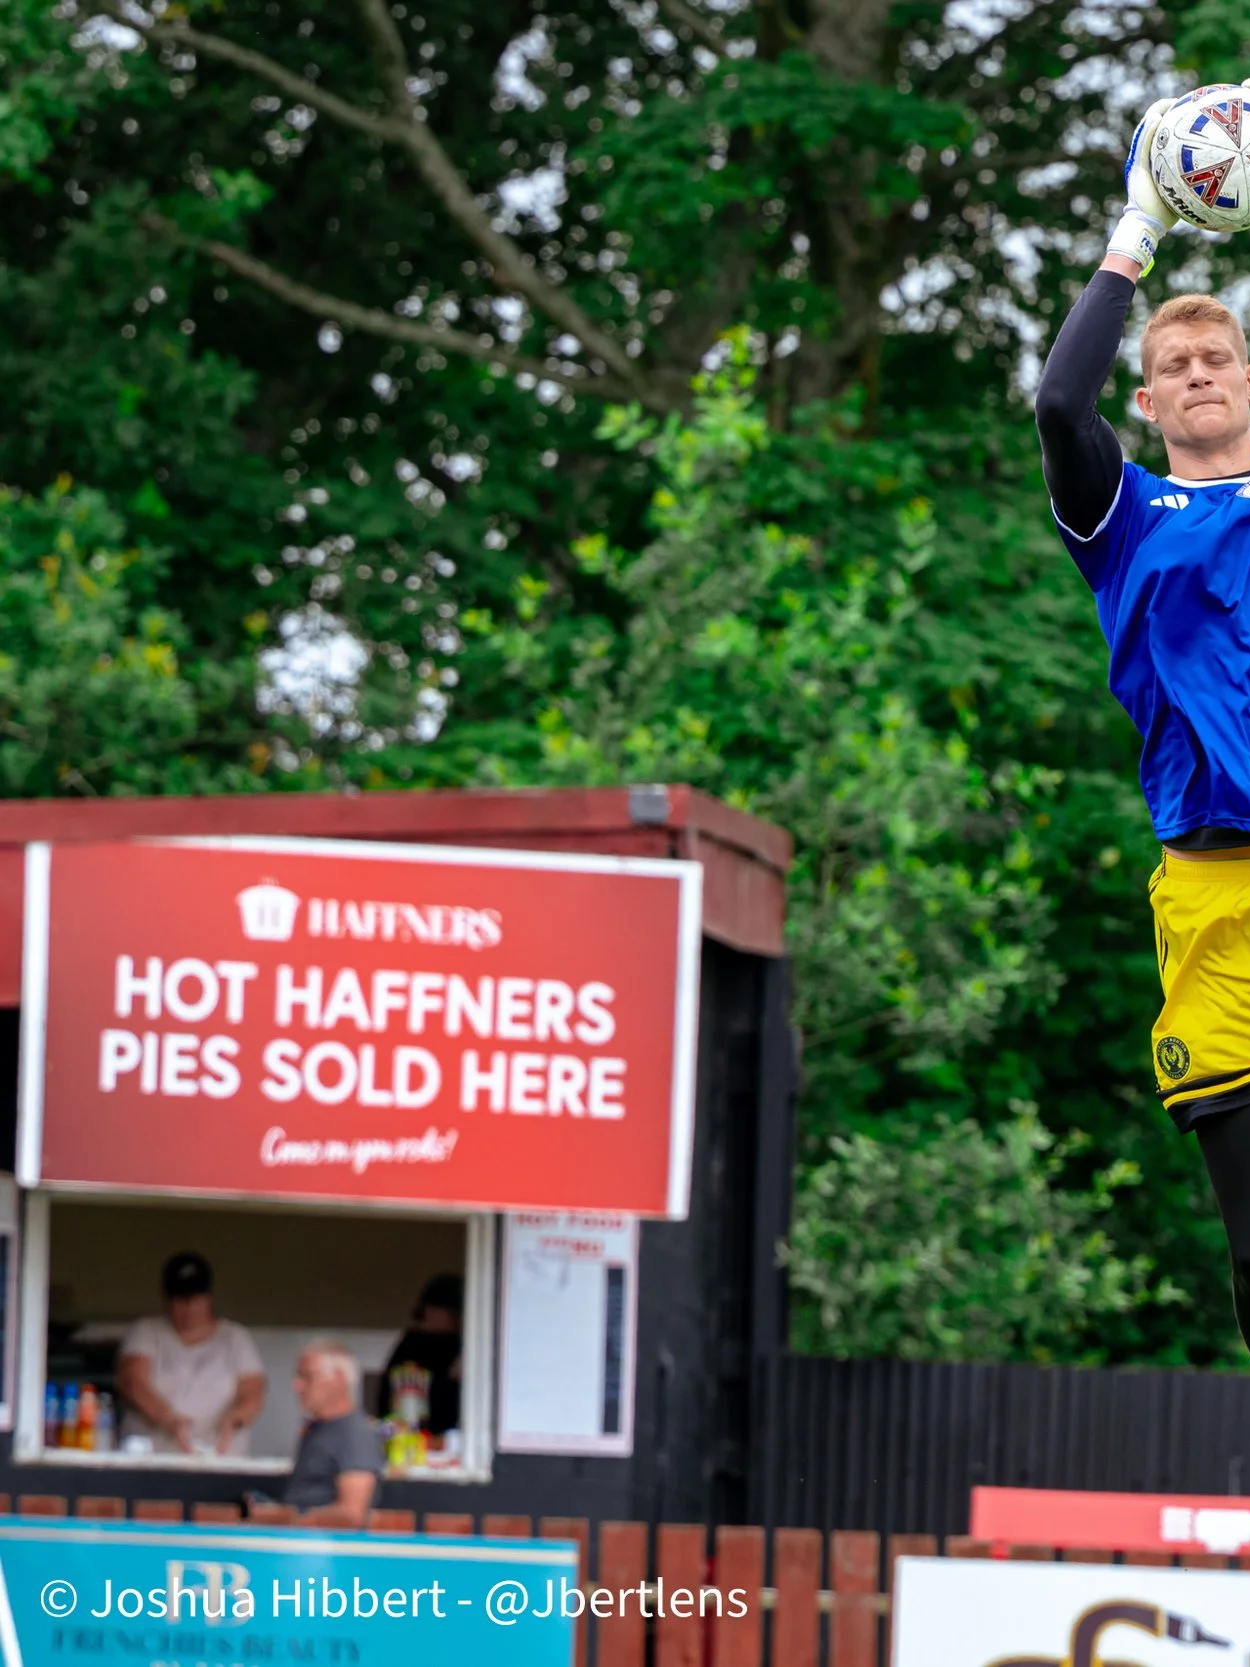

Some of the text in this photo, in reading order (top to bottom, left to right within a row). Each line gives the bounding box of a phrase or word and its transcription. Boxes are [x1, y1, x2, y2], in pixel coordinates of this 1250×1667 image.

[308, 897, 502, 951] HAFFNERS
[114, 955, 617, 1045] HOT HAFFNERS
[99, 1029, 627, 1120] PIES SOLD HERE
